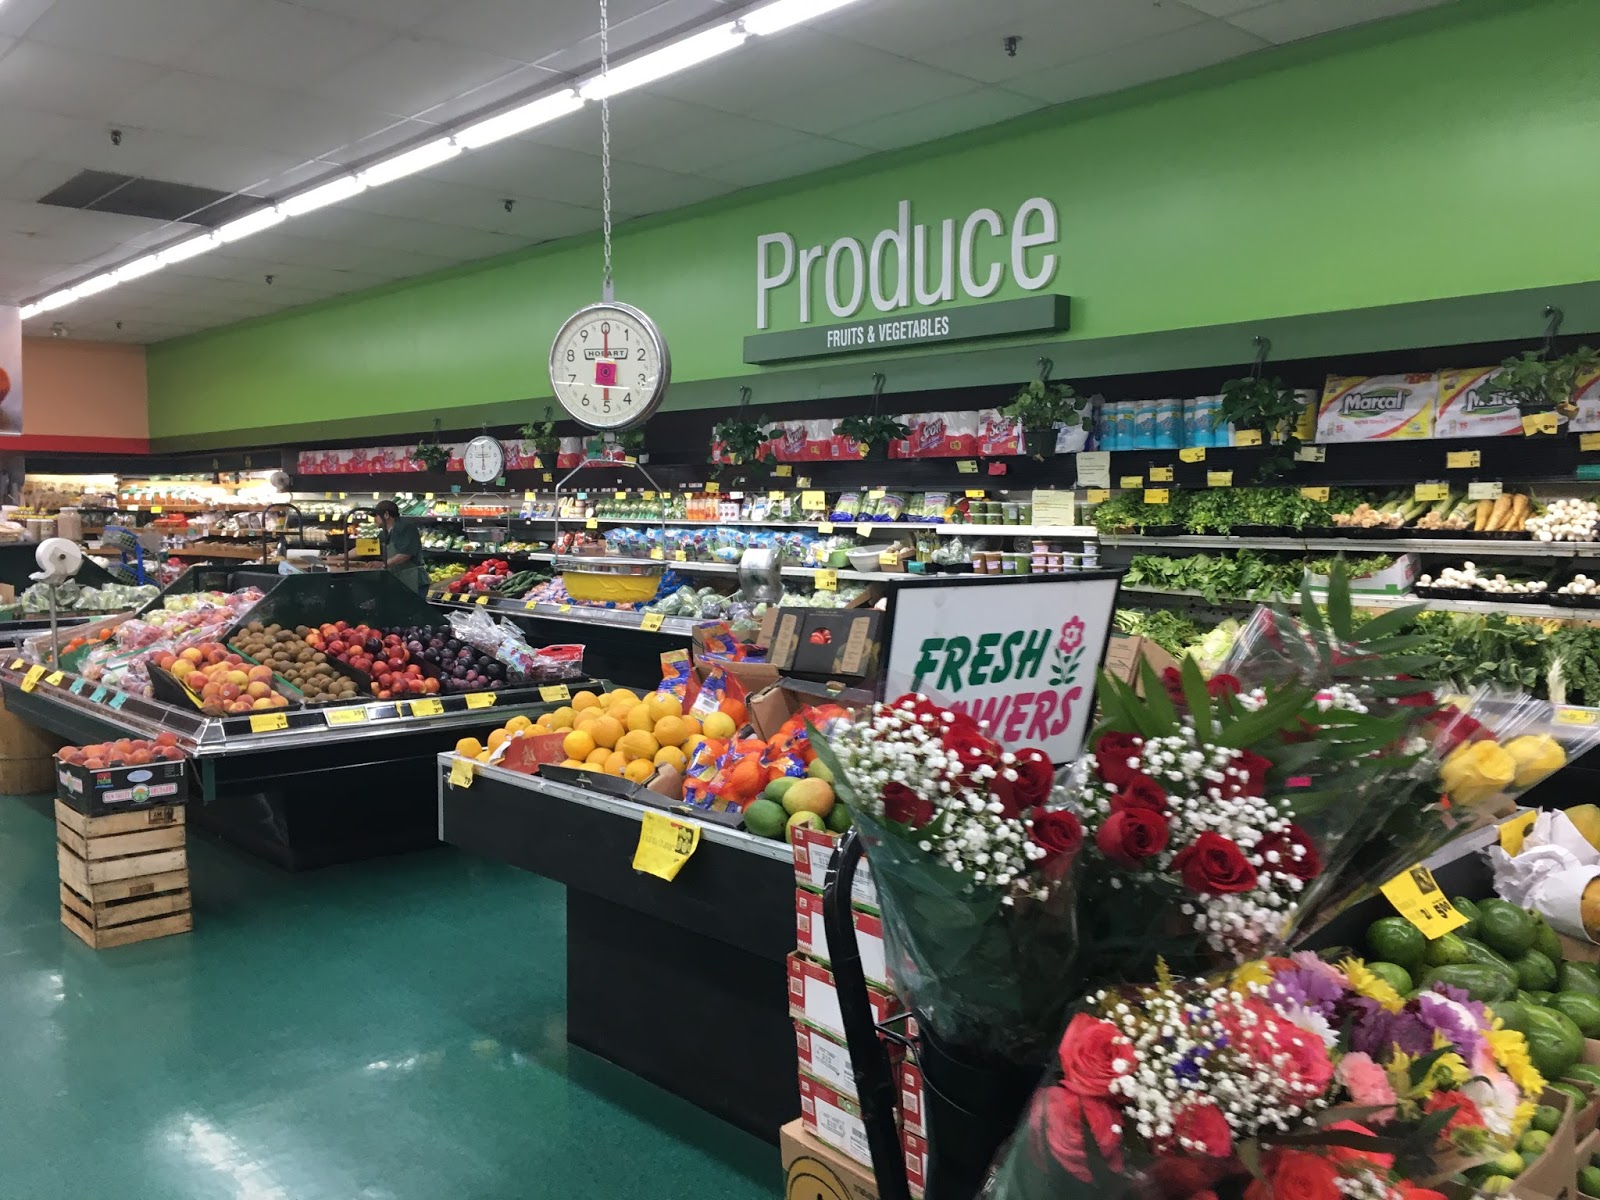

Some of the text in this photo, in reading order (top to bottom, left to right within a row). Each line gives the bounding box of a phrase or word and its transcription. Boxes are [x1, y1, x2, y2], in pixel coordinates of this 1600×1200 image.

[757, 197, 1058, 330] Produce
[580, 330, 589, 343] 9
[624, 329, 630, 341] 1
[827, 316, 950, 348] FRUITS & VEGETABLES
[567, 349, 575, 362] 8
[637, 348, 646, 361] 2
[568, 374, 576, 387] 7
[581, 394, 590, 406] 6
[623, 392, 632, 405] 4
[1341, 390, 1405, 415] Marcal
[603, 401, 611, 413] 5
[910, 628, 1052, 693] FRESH
[953, 686, 1083, 743] WERS
